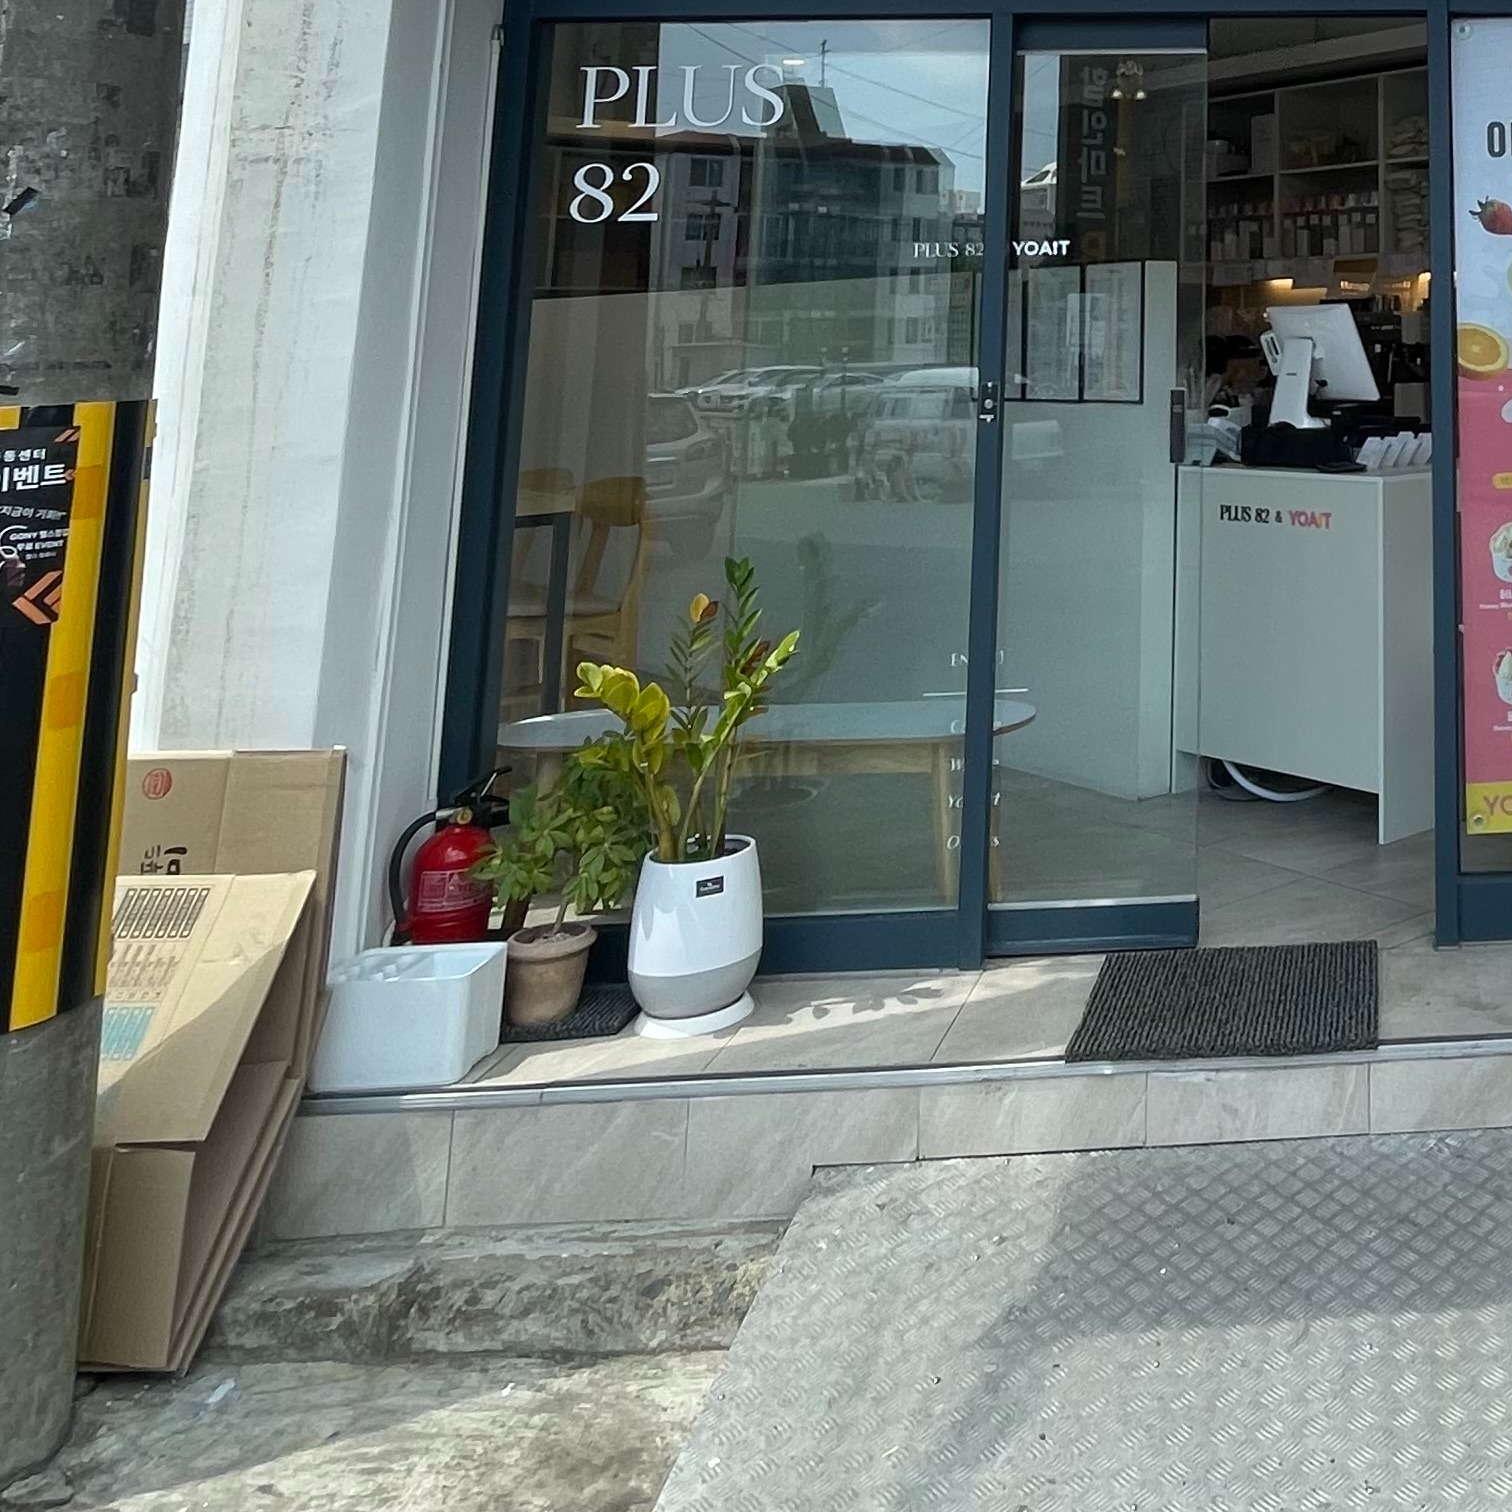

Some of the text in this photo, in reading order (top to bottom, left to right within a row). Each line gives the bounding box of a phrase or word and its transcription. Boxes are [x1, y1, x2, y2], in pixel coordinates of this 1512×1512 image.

[576, 65, 784, 128] PLUS
[569, 163, 660, 223] 82
[913, 242, 984, 258] PLUS 82
[1012, 240, 1071, 256] YOAIT
[1220, 505, 1251, 522] PLUS
[1255, 508, 1270, 523] 82
[1288, 509, 1332, 529] YOAIT
